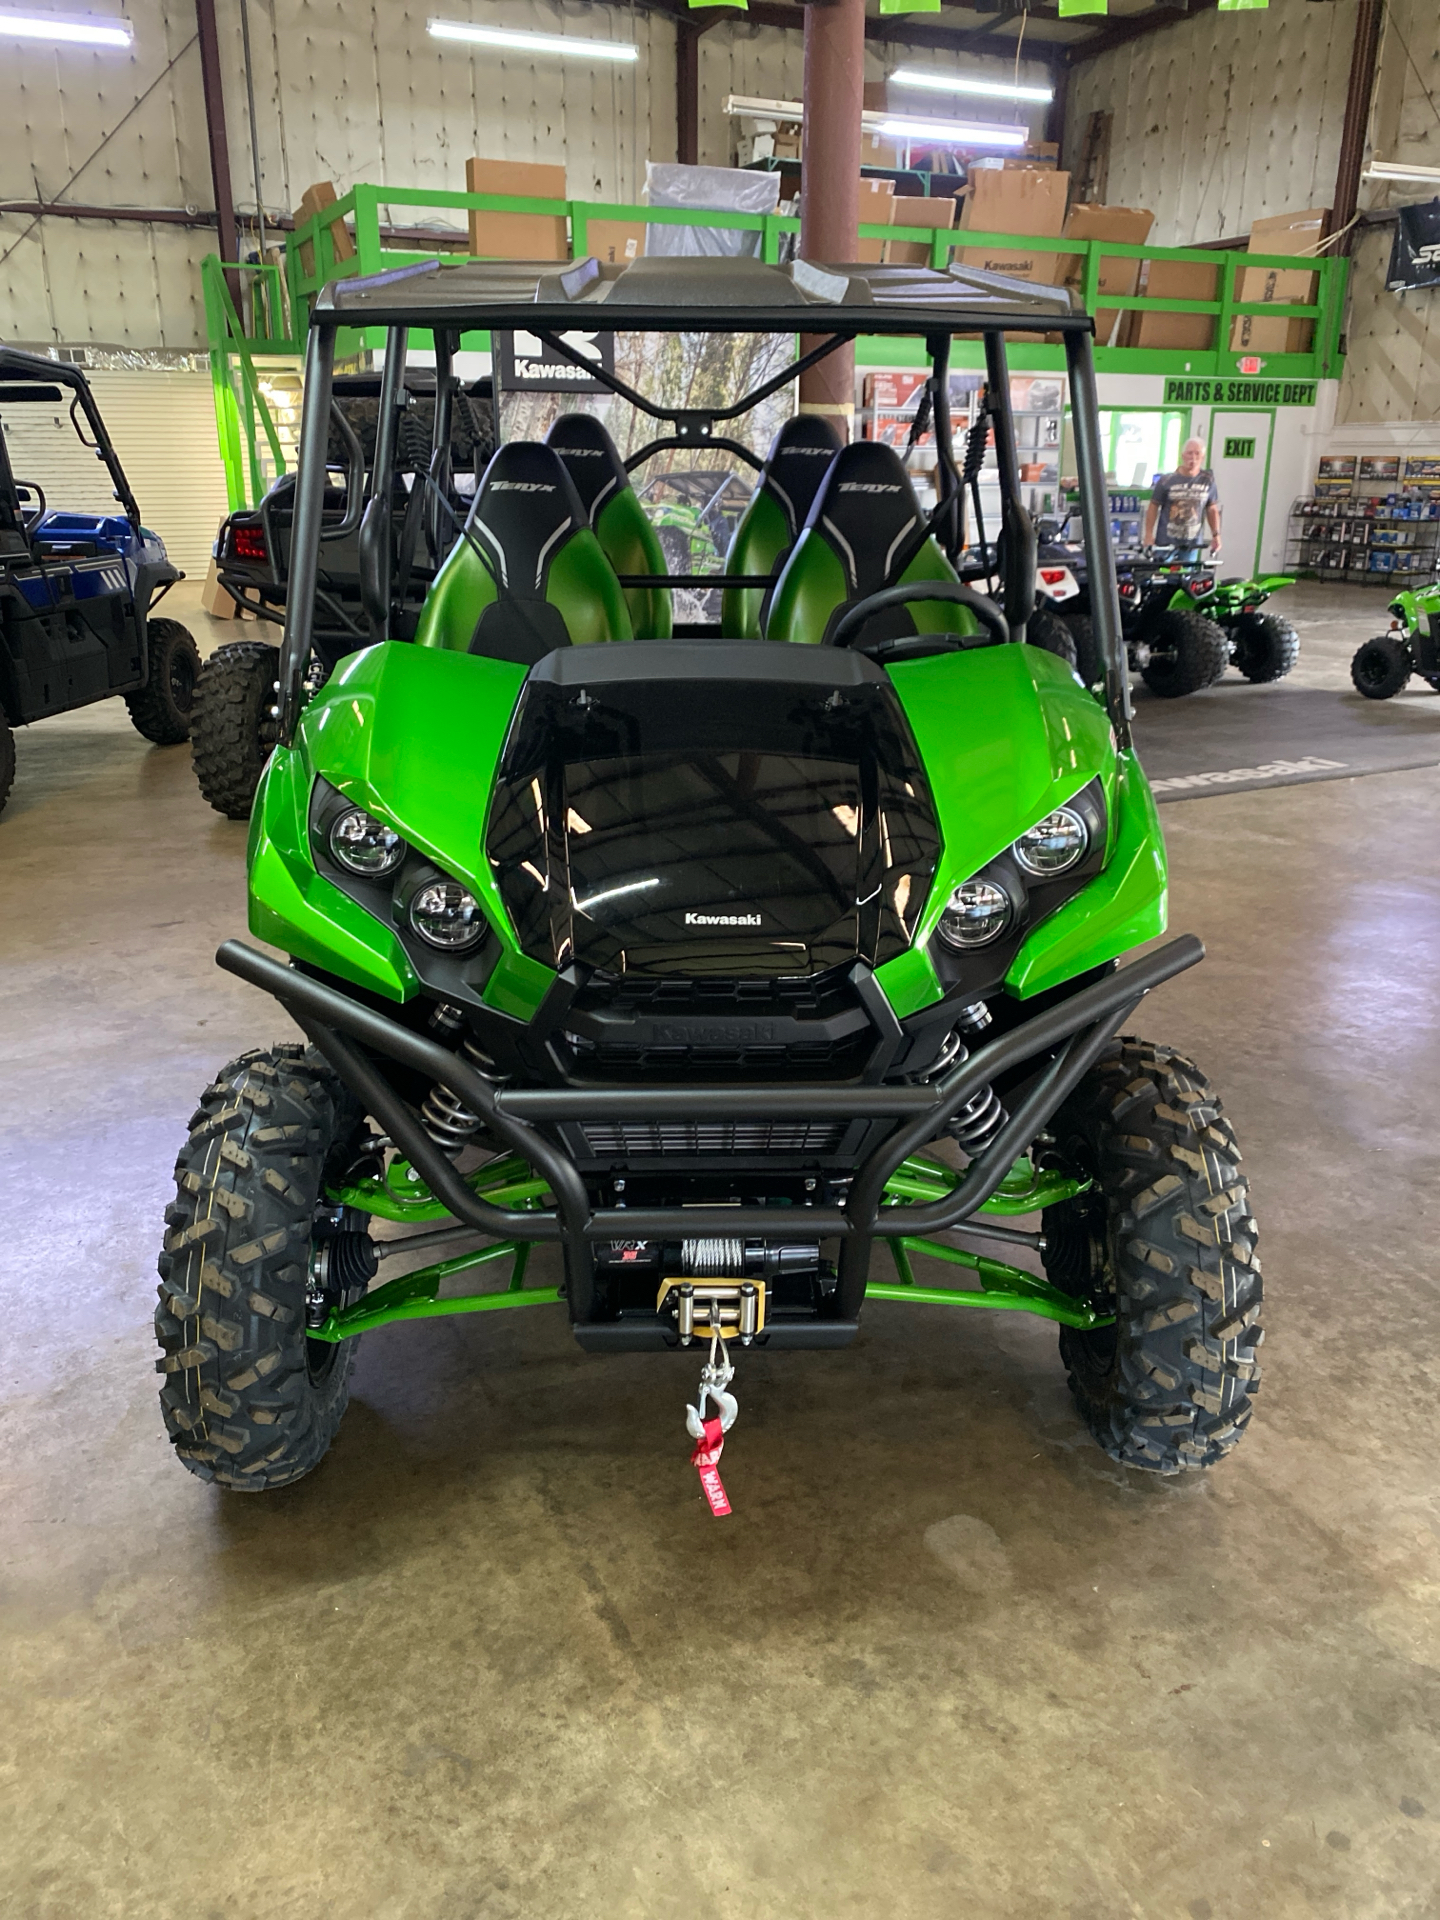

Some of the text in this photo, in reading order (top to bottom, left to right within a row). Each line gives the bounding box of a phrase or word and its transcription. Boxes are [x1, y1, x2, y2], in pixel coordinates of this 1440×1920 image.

[514, 359, 603, 380] Kawasa
[1168, 381, 1315, 403] PARTS & SERVICE DEPT
[1225, 439, 1254, 457] EXIT
[685, 912, 761, 926] Kawasaki
[653, 1022, 774, 1041] Kawasaki
[702, 1470, 727, 1509] WARN
